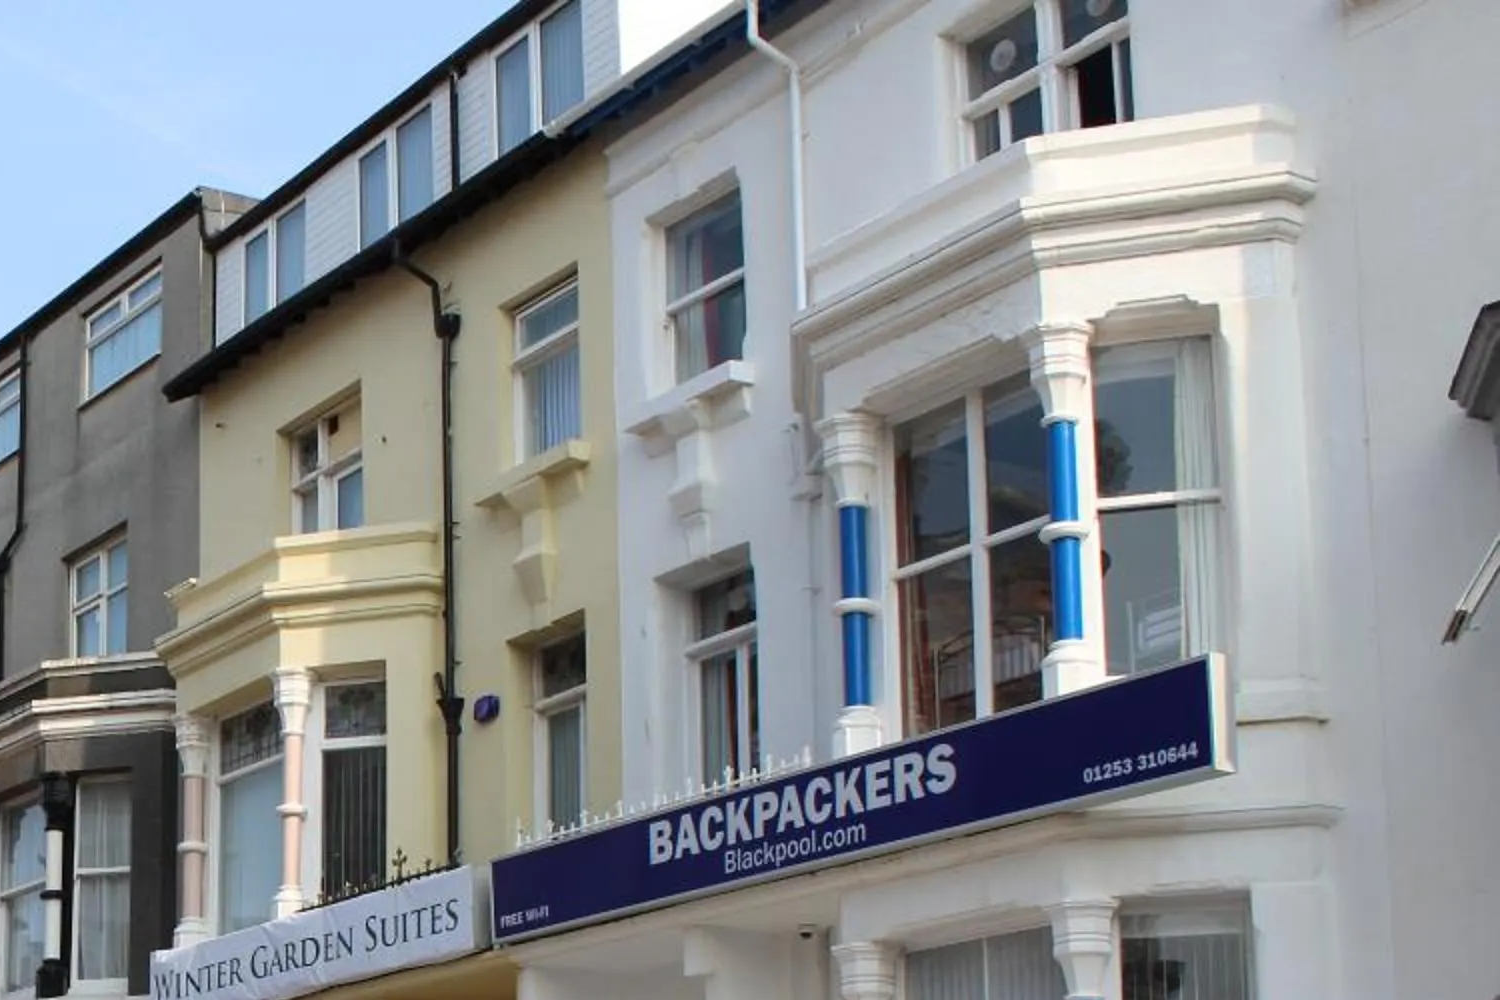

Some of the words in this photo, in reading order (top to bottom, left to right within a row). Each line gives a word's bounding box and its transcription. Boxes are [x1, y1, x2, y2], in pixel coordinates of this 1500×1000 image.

[1083, 757, 1134, 784] 01253
[1136, 741, 1199, 771] 310644
[649, 743, 957, 866] BACKPACKERS
[723, 822, 867, 875] Blackpool.com
[250, 926, 354, 980] GARDEN
[364, 898, 460, 953] SUITES
[500, 911, 524, 929] FREE
